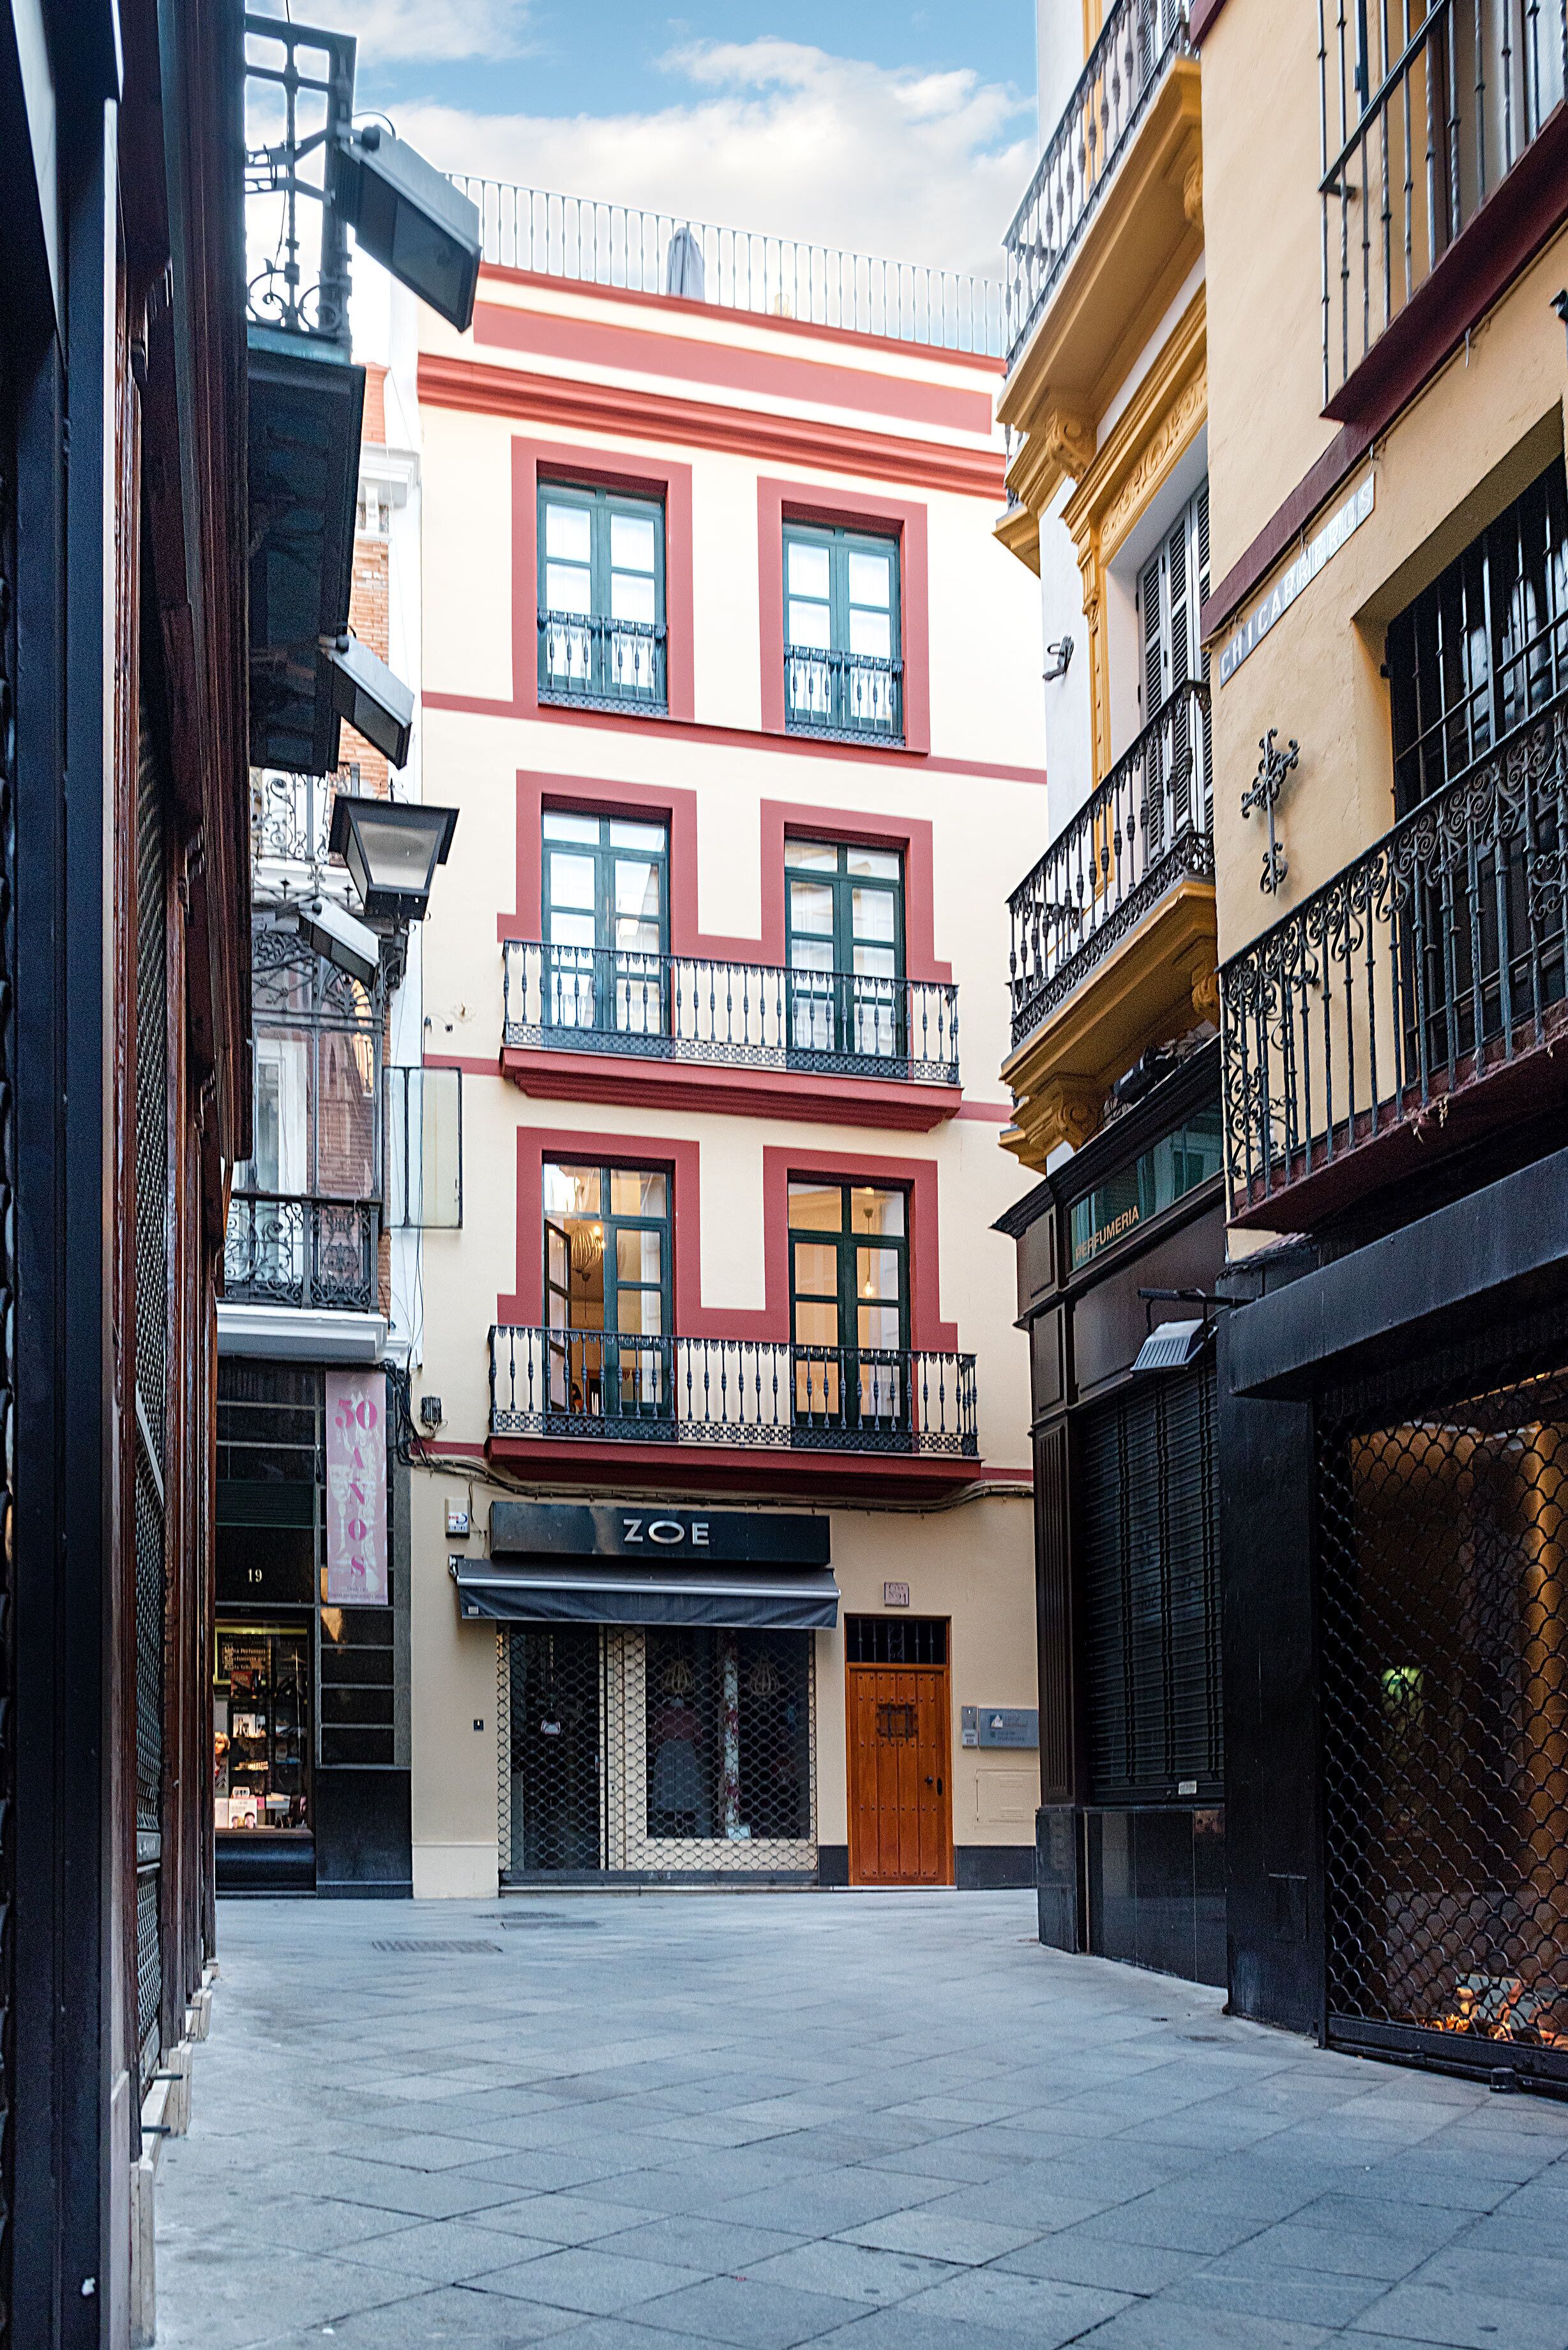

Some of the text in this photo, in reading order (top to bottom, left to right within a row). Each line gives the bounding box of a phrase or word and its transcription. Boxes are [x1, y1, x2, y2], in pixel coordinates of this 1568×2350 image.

[1220, 483, 1372, 679] CHICARREROS
[1075, 1205, 1139, 1262] PERFUMERIA
[335, 1399, 377, 1429] 50
[623, 1519, 709, 1545] ZOE
[248, 1568, 262, 1582] 19
